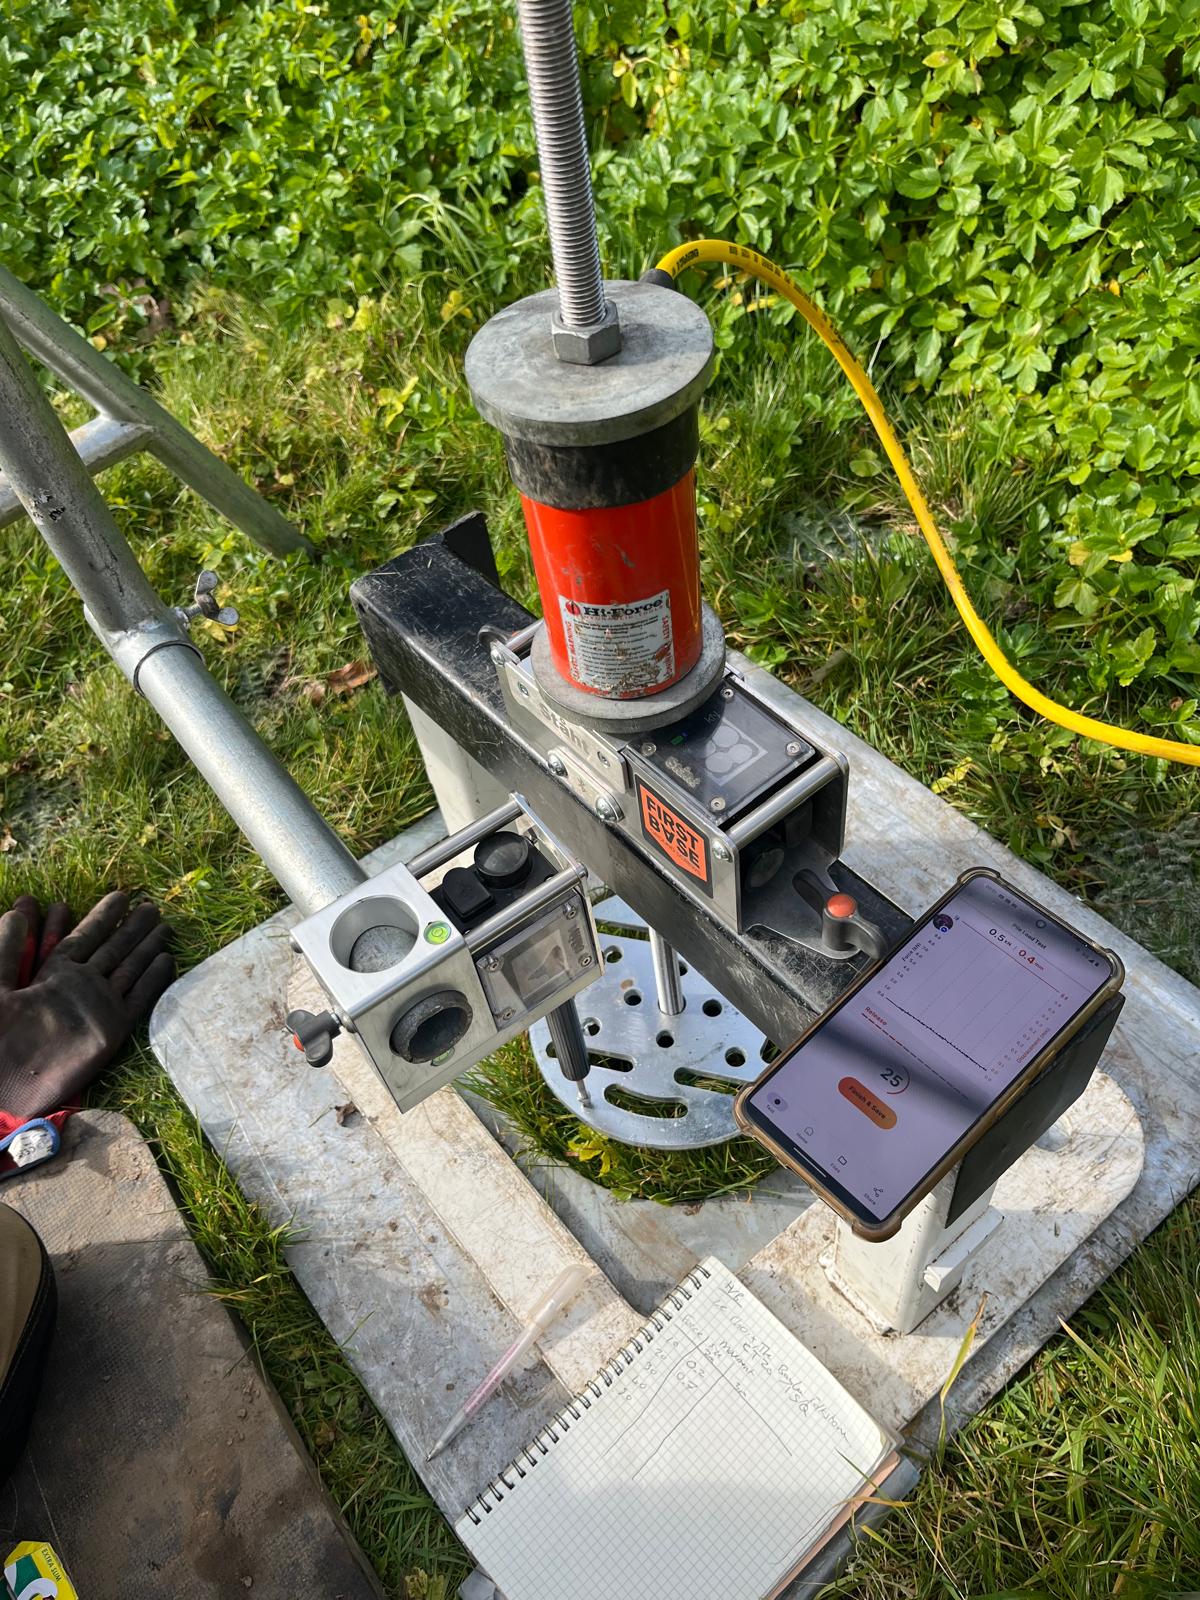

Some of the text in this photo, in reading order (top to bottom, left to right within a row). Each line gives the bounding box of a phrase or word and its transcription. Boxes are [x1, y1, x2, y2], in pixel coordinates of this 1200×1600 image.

[583, 599, 663, 616] Hi-Force
[646, 793, 700, 854] FIRST
[988, 927, 1005, 942] 0.5
[1017, 948, 1035, 964] 0.4
[863, 1005, 887, 1026] Release
[879, 1066, 903, 1088] 25
[847, 1085, 867, 1104] Finish
[870, 1104, 887, 1120] Save
[685, 1357, 707, 1379] 0.2
[42, 1548, 53, 1568] EXTRA
